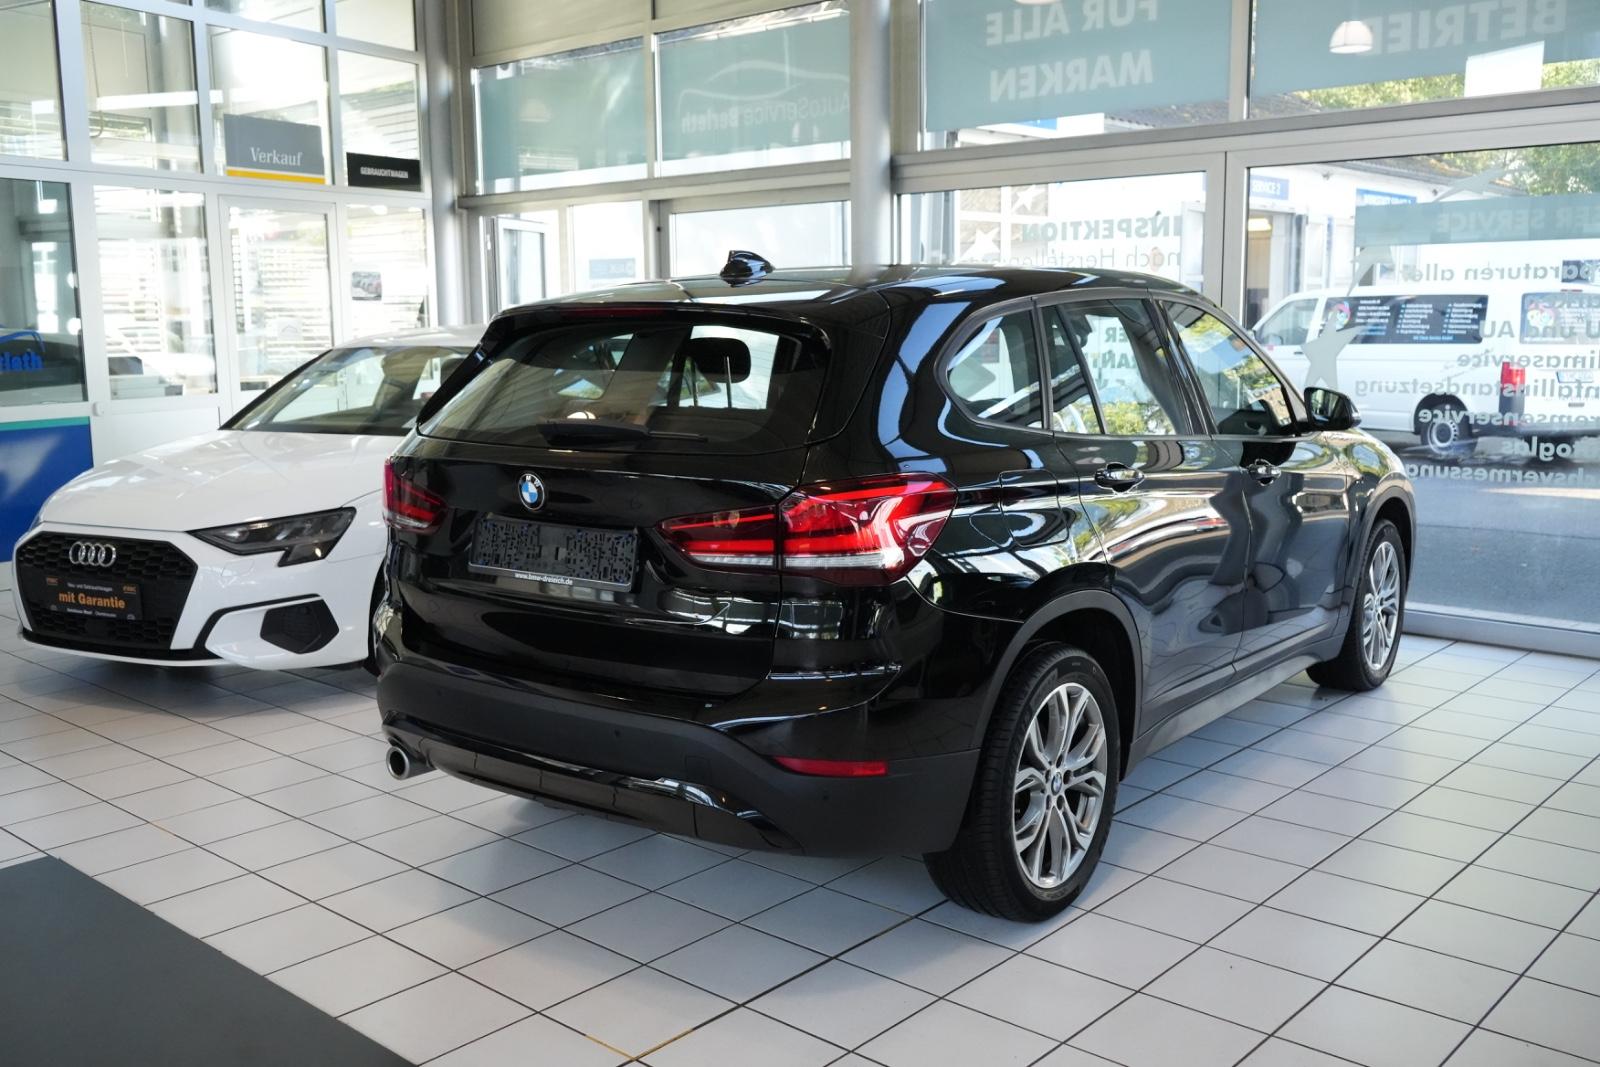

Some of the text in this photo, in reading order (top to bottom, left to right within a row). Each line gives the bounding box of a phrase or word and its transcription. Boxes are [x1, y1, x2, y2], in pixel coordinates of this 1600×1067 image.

[250, 147, 303, 167] Verkauf
[360, 166, 408, 179] GEBRAUCHTWAGEN
[58, 592, 126, 609] mit Garantie
